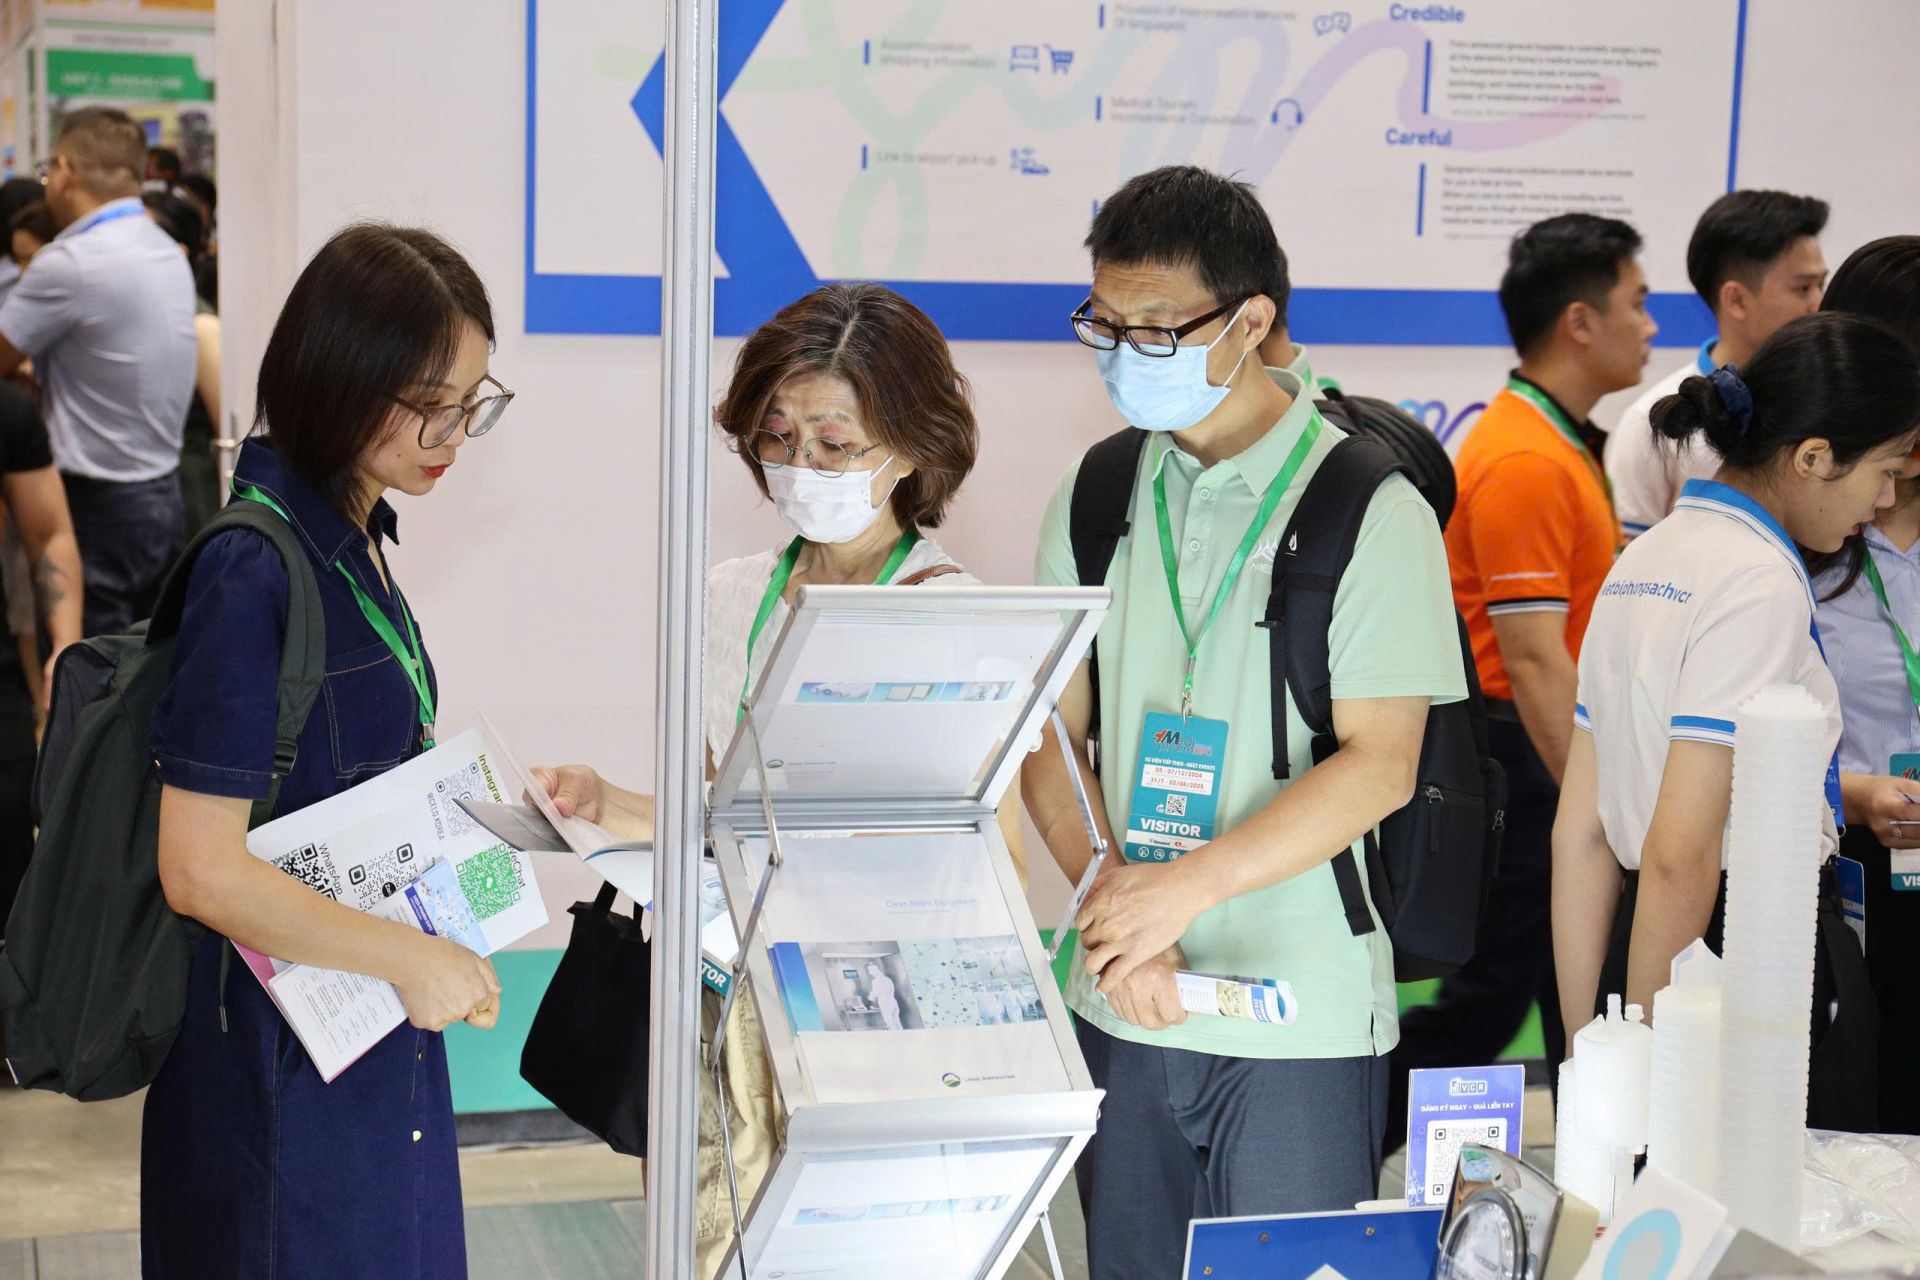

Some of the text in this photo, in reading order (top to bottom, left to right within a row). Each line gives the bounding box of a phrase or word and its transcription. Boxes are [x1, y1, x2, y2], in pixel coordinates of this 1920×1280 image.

[1389, 3, 1466, 23] Credible
[1386, 128, 1452, 147] Careful
[1140, 818, 1201, 837] VISITOR
[319, 843, 342, 895] WhatsApp
[1461, 1082, 1485, 1093] VCR
